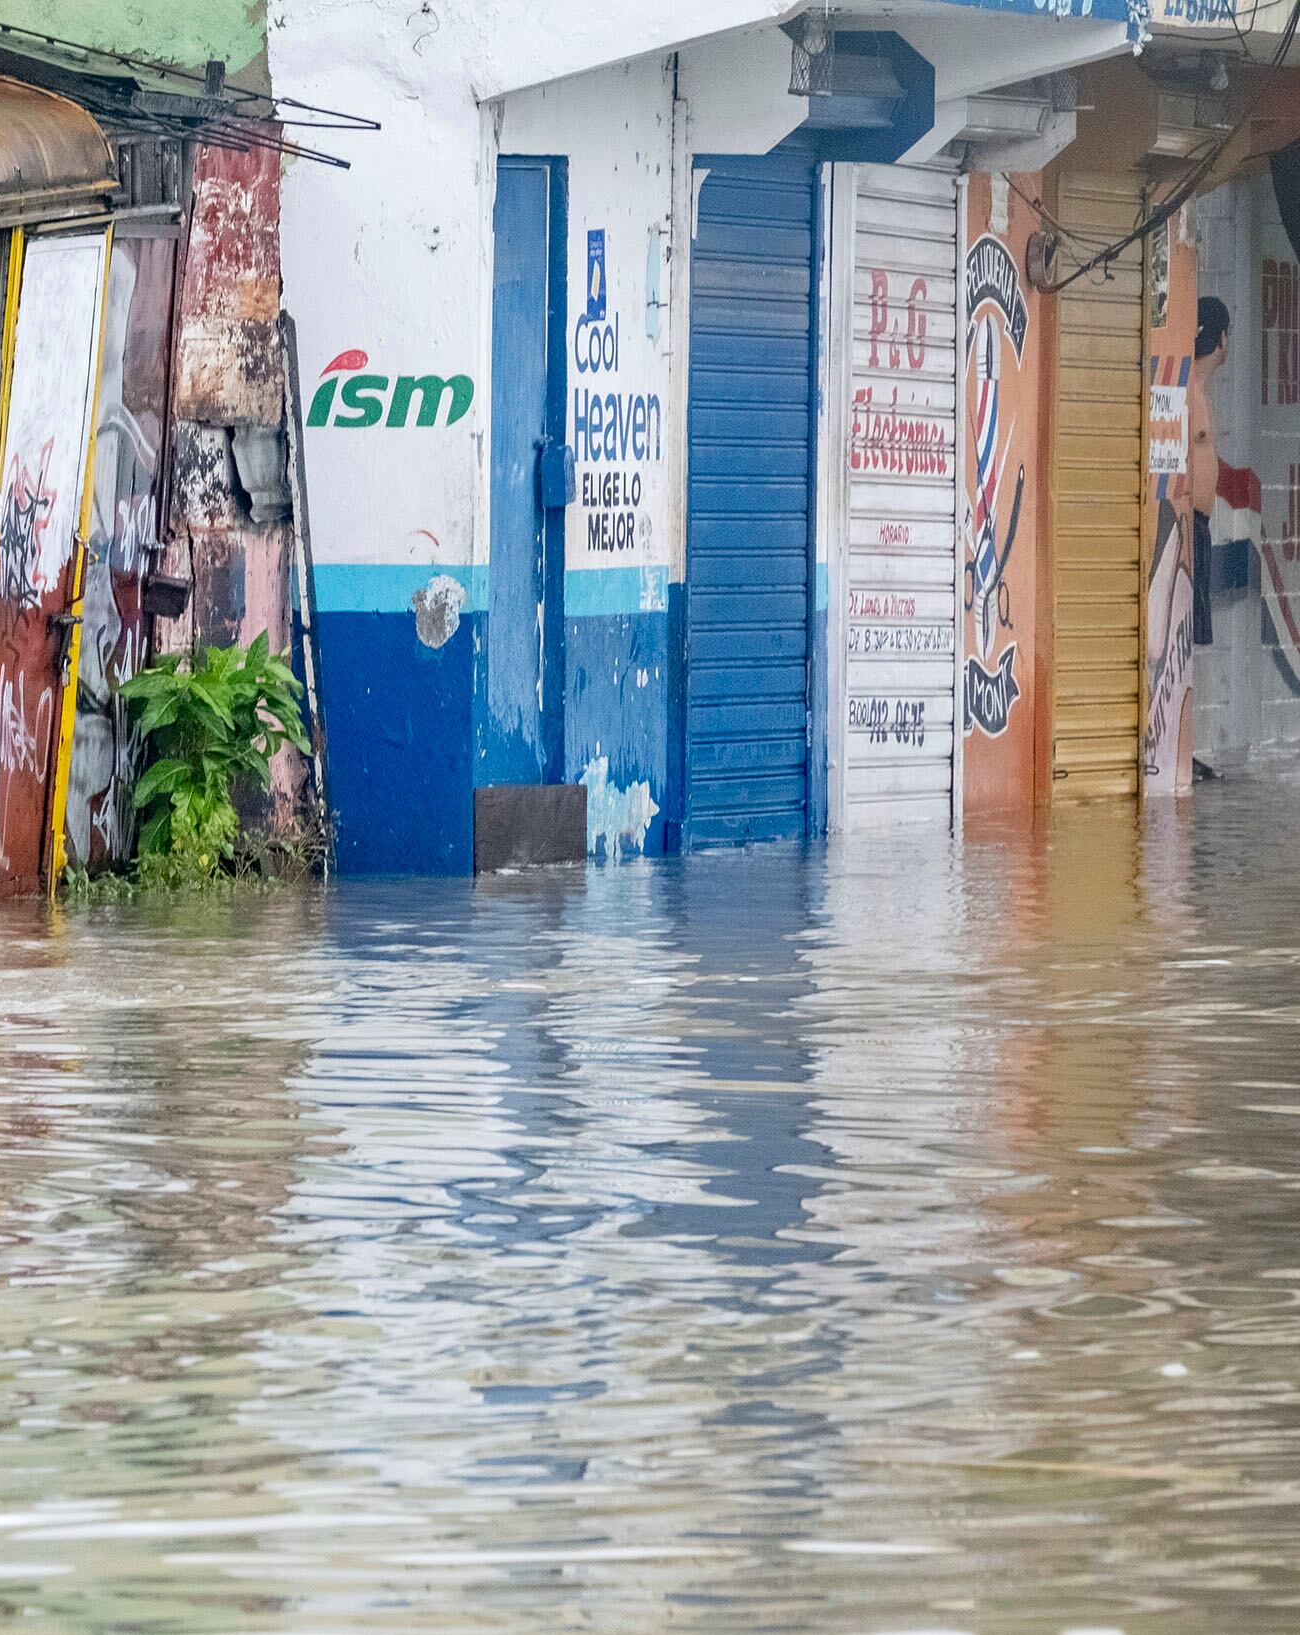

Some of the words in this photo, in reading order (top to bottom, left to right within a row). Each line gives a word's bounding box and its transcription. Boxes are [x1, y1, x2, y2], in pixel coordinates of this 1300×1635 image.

[965, 243, 1014, 311] PELUQUERIA
[575, 312, 619, 374] Cool
[306, 349, 475, 428] ism
[574, 388, 661, 463] Heaven
[582, 472, 619, 508] ELIGE
[623, 472, 641, 507] LO
[588, 512, 635, 552] MEJOR
